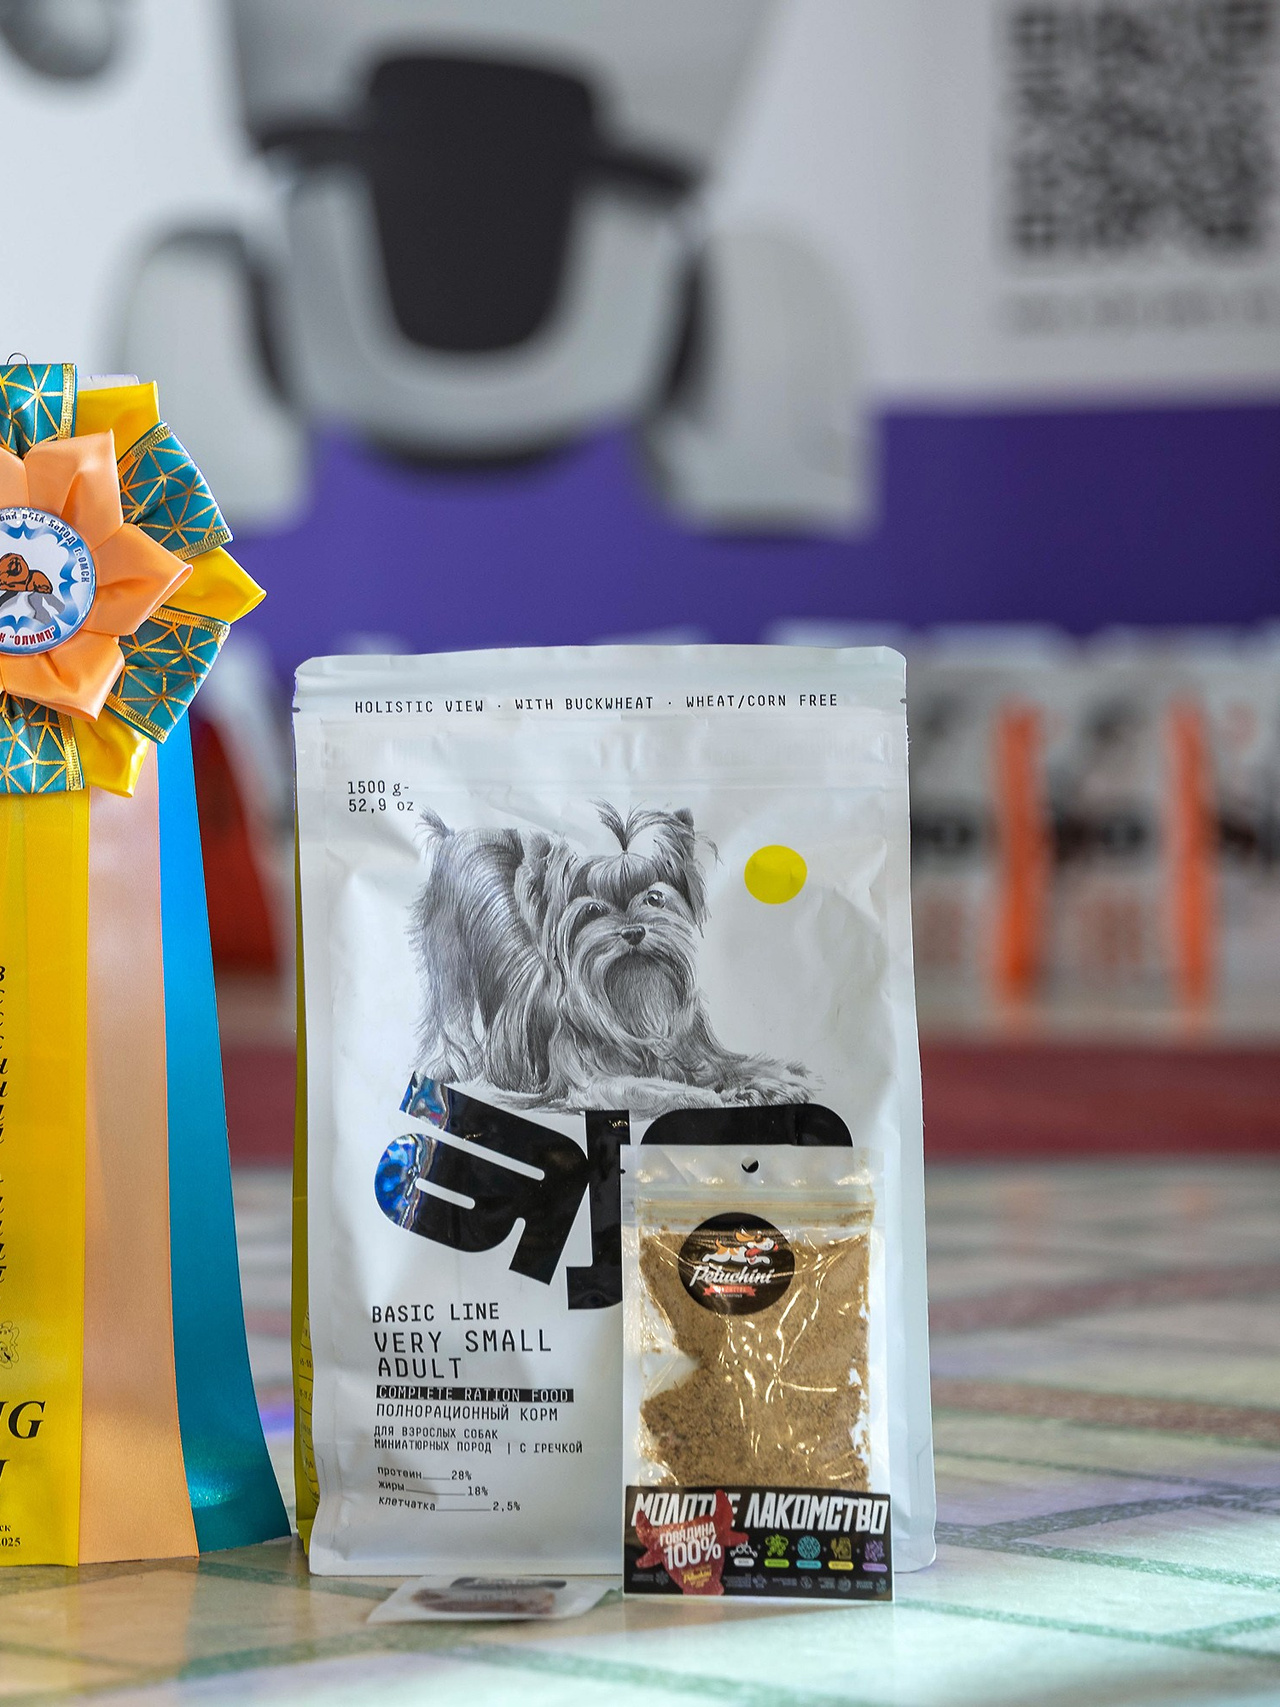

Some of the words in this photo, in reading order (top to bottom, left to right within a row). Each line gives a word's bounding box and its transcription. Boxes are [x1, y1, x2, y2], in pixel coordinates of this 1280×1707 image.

[354, 701, 433, 713] HOLISTIC
[445, 700, 484, 712] VIEW
[515, 698, 554, 710] WITH
[565, 697, 654, 710] BUCKWHEAT
[686, 694, 786, 708] WHEAT/CORN
[799, 693, 838, 706] FREE
[347, 780, 386, 794] 1500
[348, 798, 387, 813] 52,9
[397, 801, 414, 811] oz
[372, 1304, 435, 1323] BASIC
[450, 1302, 499, 1320] LINE
[374, 1331, 442, 1353] VERY
[465, 1329, 551, 1352] SMALL
[378, 1357, 461, 1379] ADULT
[379, 1385, 453, 1400] COMPLETE
[464, 1387, 520, 1401] RATION
[531, 1388, 569, 1402] FOOD
[376, 1403, 509, 1421] ПОЛНОРАЦИОННЫЙ
[520, 1407, 558, 1421] КОРМ
[374, 1426, 394, 1437] ДЛЯ
[402, 1427, 456, 1439] ВЗРОСЛЫХ
[464, 1429, 498, 1439] СОБАК
[375, 1439, 449, 1451] МИНИАТЮРНЫХ
[457, 1441, 492, 1454] ПОРОД
[534, 1441, 583, 1453] ГРЕЧКОЙ
[377, 1466, 422, 1480] протеин
[451, 1471, 472, 1480] 28%
[378, 1481, 405, 1492] жиры
[468, 1486, 489, 1496] 18%
[493, 1501, 520, 1512] 2,5%
[631, 1492, 742, 1527] МОЛОТЕ
[744, 1492, 889, 1534] ЛАКОМСТВО
[659, 1521, 716, 1547] ГОВЯДИНА
[664, 1533, 721, 1571] 100%
